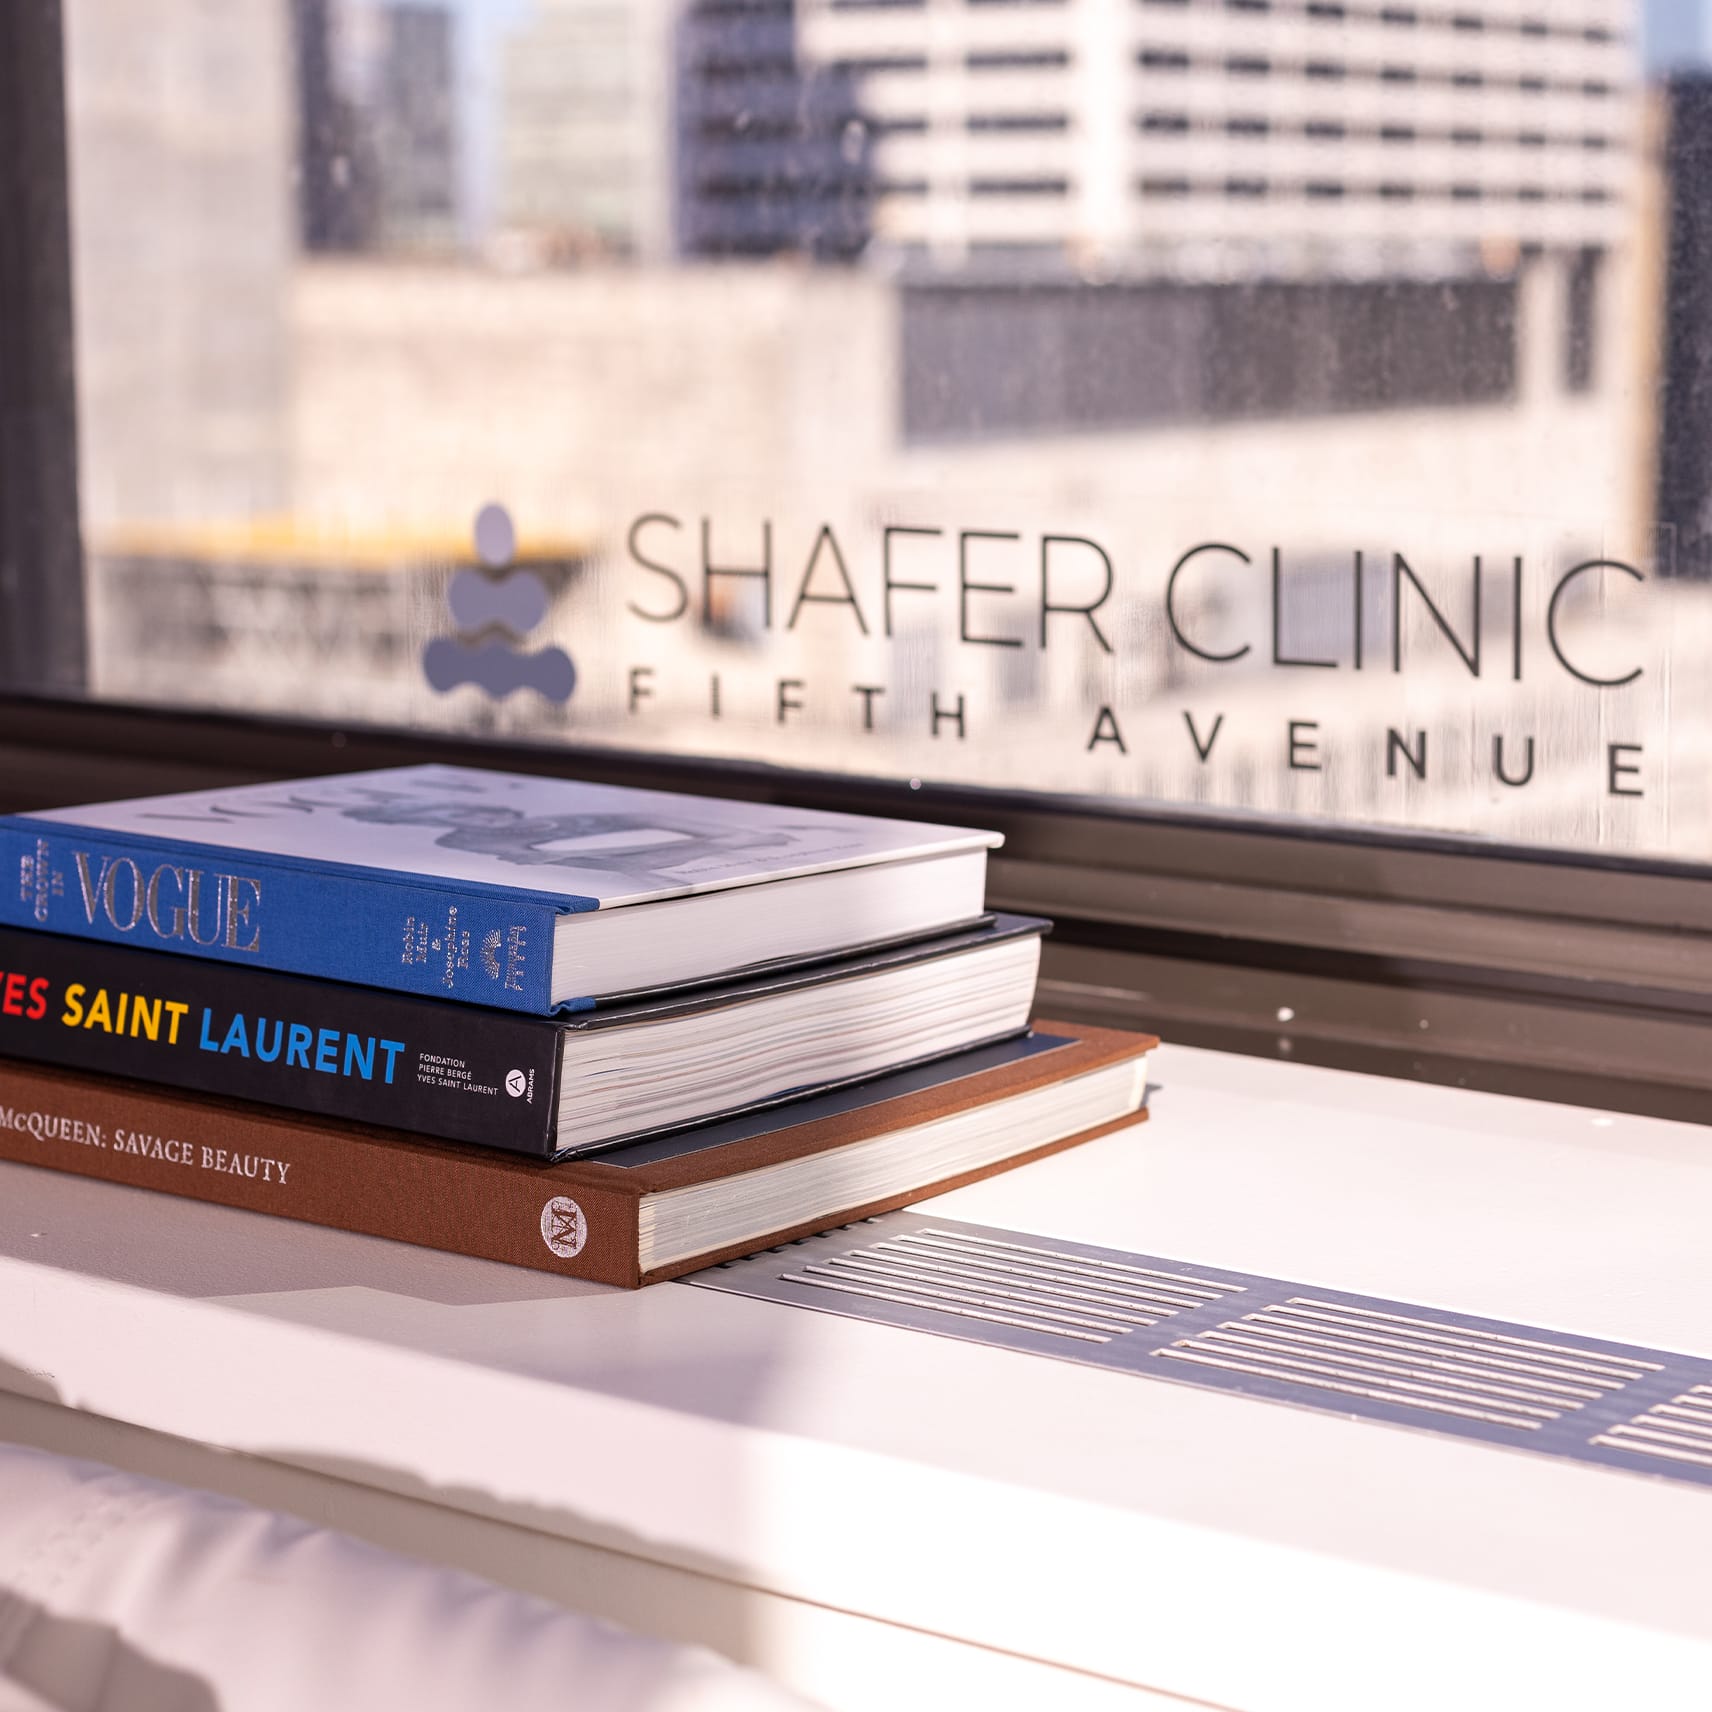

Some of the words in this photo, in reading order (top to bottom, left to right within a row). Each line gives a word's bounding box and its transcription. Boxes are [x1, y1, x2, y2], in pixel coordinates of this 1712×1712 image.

[627, 512, 1115, 656] SHAFER
[1166, 543, 1646, 688] CLINIC
[628, 667, 967, 739] FIFTH
[1087, 705, 1645, 797] AVENUE
[73, 852, 261, 952] VOGUE
[0, 971, 50, 1021] ES
[61, 983, 189, 1045] SAINT
[199, 1007, 405, 1084] LAURENT
[420, 1053, 465, 1068] FONDATION
[417, 1074, 436, 1085] YVES
[438, 1078, 461, 1089] SAINT
[463, 1083, 498, 1095] LAURENT
[419, 1064, 445, 1076] PIERRE
[447, 1070, 472, 1080] BERGÉ
[526, 1069, 535, 1104] ABRAMS
[0, 1105, 107, 1149] McQUEEN:
[113, 1129, 194, 1166] SAVAGE
[201, 1146, 291, 1185] BEAUTY
